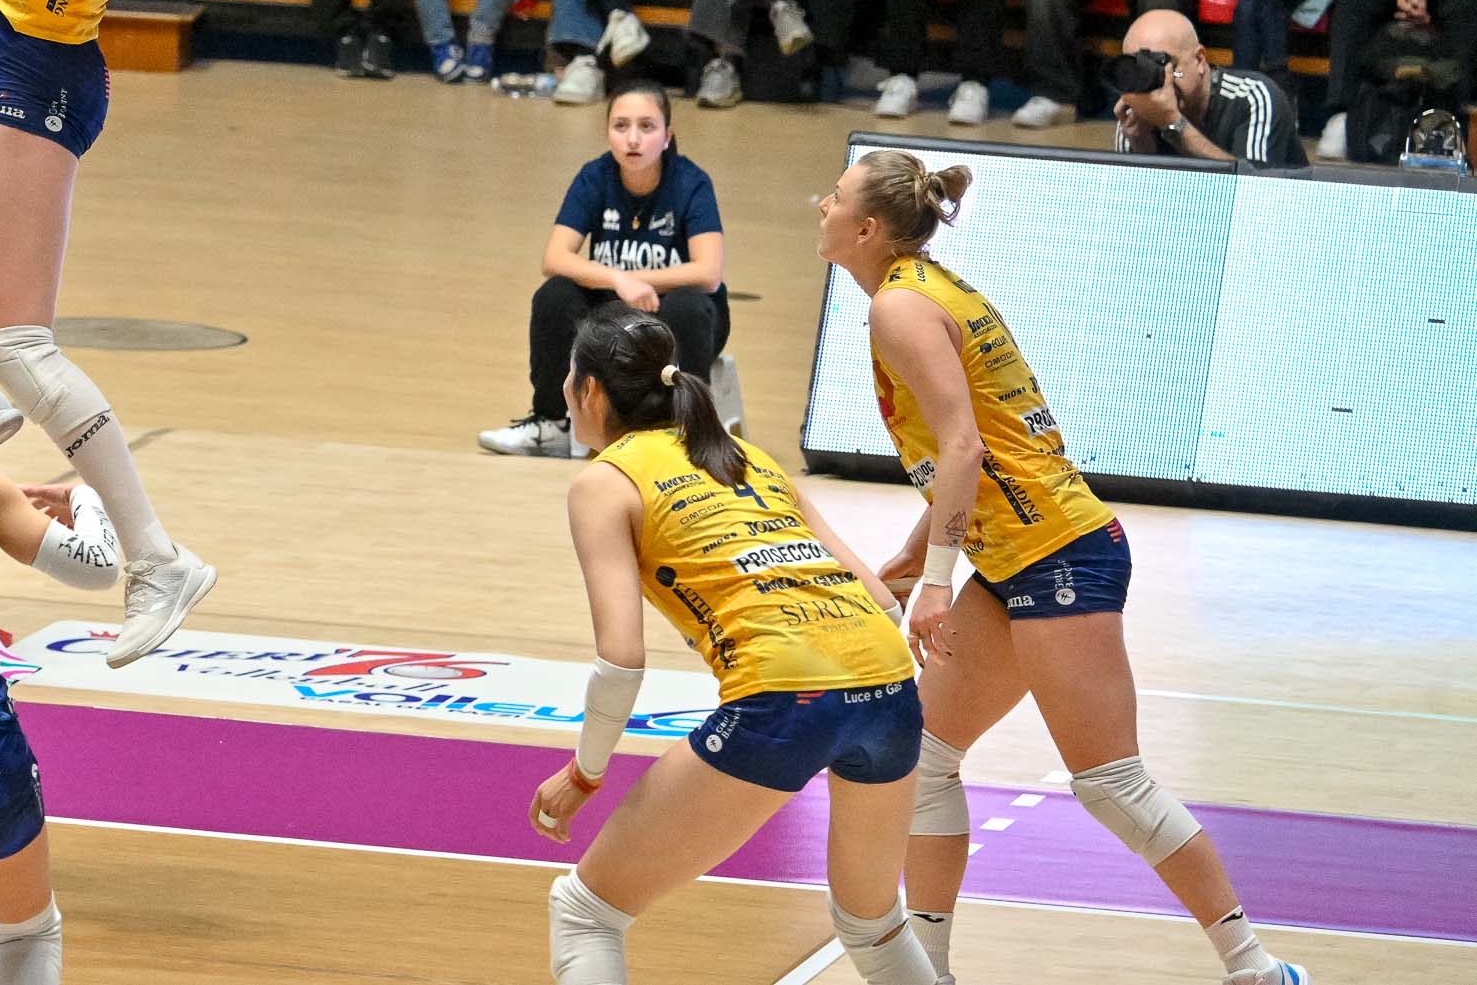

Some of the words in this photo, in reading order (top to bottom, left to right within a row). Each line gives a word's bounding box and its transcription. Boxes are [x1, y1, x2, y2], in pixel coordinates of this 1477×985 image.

[744, 515, 801, 537] Joma
[736, 542, 822, 574] PROSECCO
[844, 690, 871, 704] Luce
[875, 689, 884, 700] e
[885, 681, 903, 696] Gas
